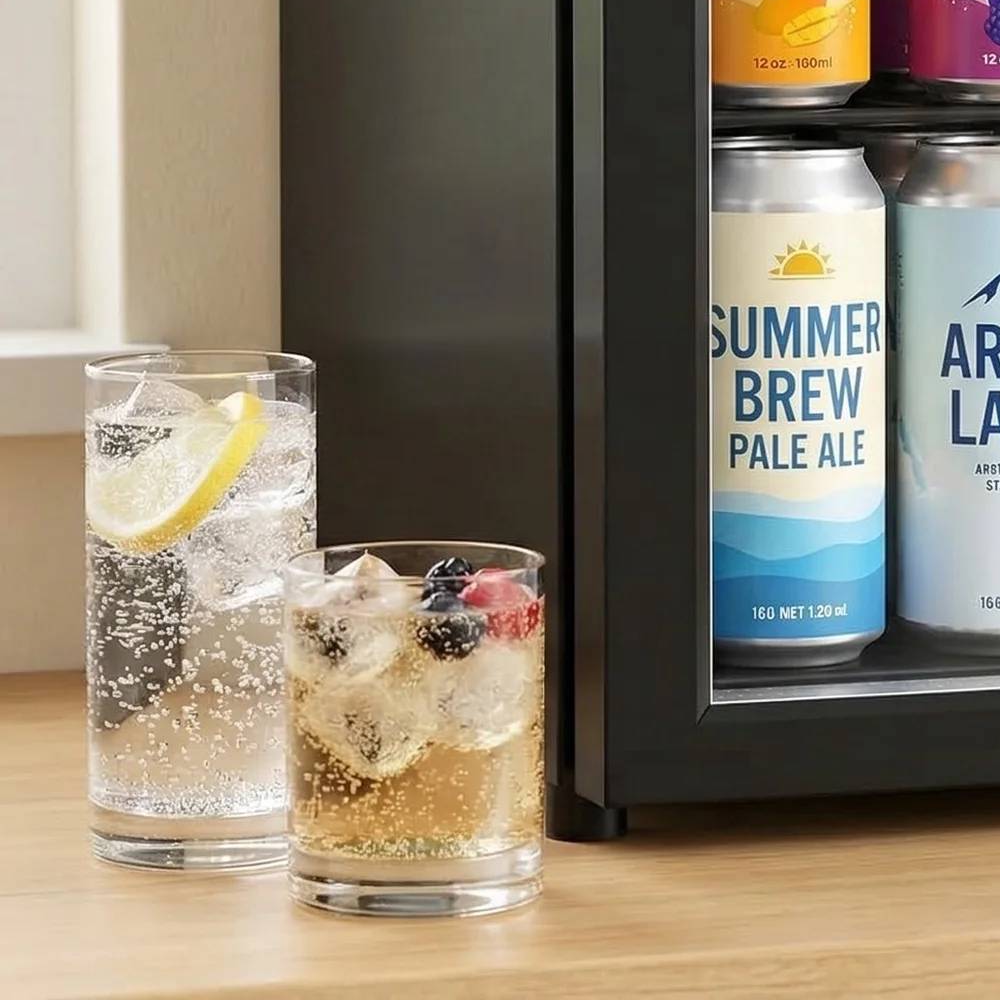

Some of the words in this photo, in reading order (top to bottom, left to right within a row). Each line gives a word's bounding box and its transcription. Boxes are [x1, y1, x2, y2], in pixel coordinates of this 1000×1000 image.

[711, 301, 881, 359] SUMMER
[734, 366, 862, 423] BREW
[729, 432, 808, 471] PALE
[818, 429, 866, 469] ALE
